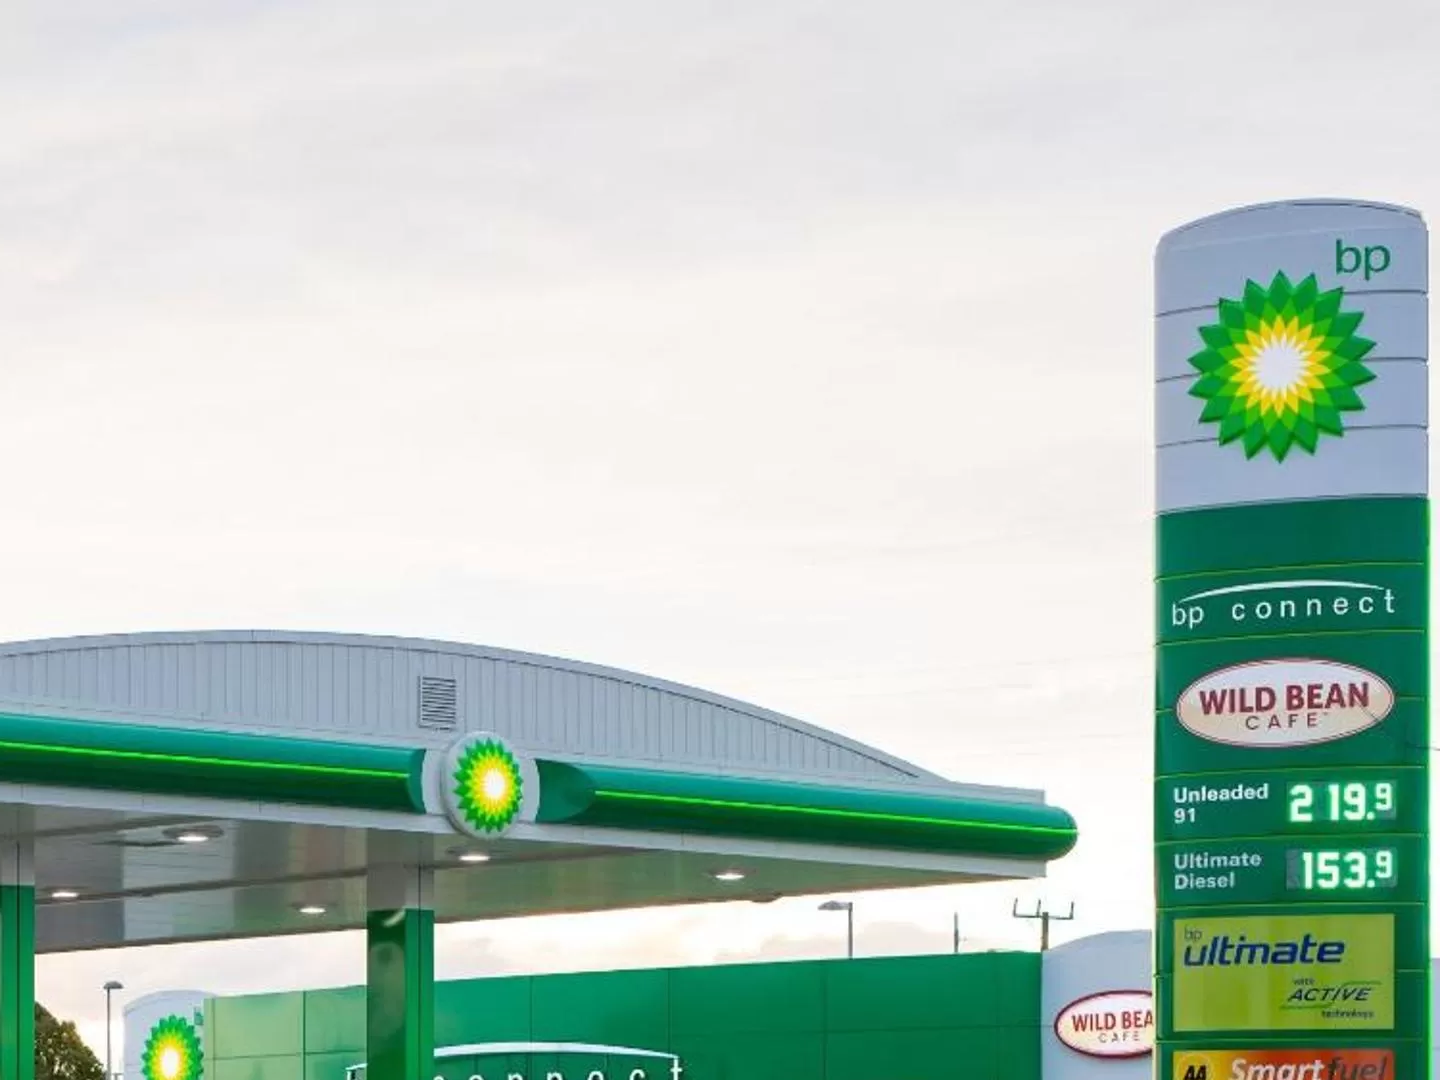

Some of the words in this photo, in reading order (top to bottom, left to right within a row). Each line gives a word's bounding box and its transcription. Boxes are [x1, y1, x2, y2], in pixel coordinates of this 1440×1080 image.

[1336, 239, 1390, 281] bp
[1172, 604, 1205, 629] bp
[1232, 589, 1395, 620] connect
[1199, 687, 1276, 716] WILD
[1286, 682, 1370, 711] BEAN
[1245, 712, 1319, 731] CAFE
[1173, 783, 1269, 803] Unleaded
[1174, 808, 1196, 823] 91
[1174, 852, 1262, 870] Ultimate
[1302, 851, 1393, 889] 153.9
[1174, 872, 1235, 890] Diesel
[1184, 927, 1202, 942] bp
[1184, 934, 1345, 967] ultimate
[1288, 987, 1372, 1002] ACTIVE
[1072, 1012, 1116, 1032] WILD
[1121, 1010, 1153, 1030] BEA
[1098, 1031, 1141, 1044] CAFE
